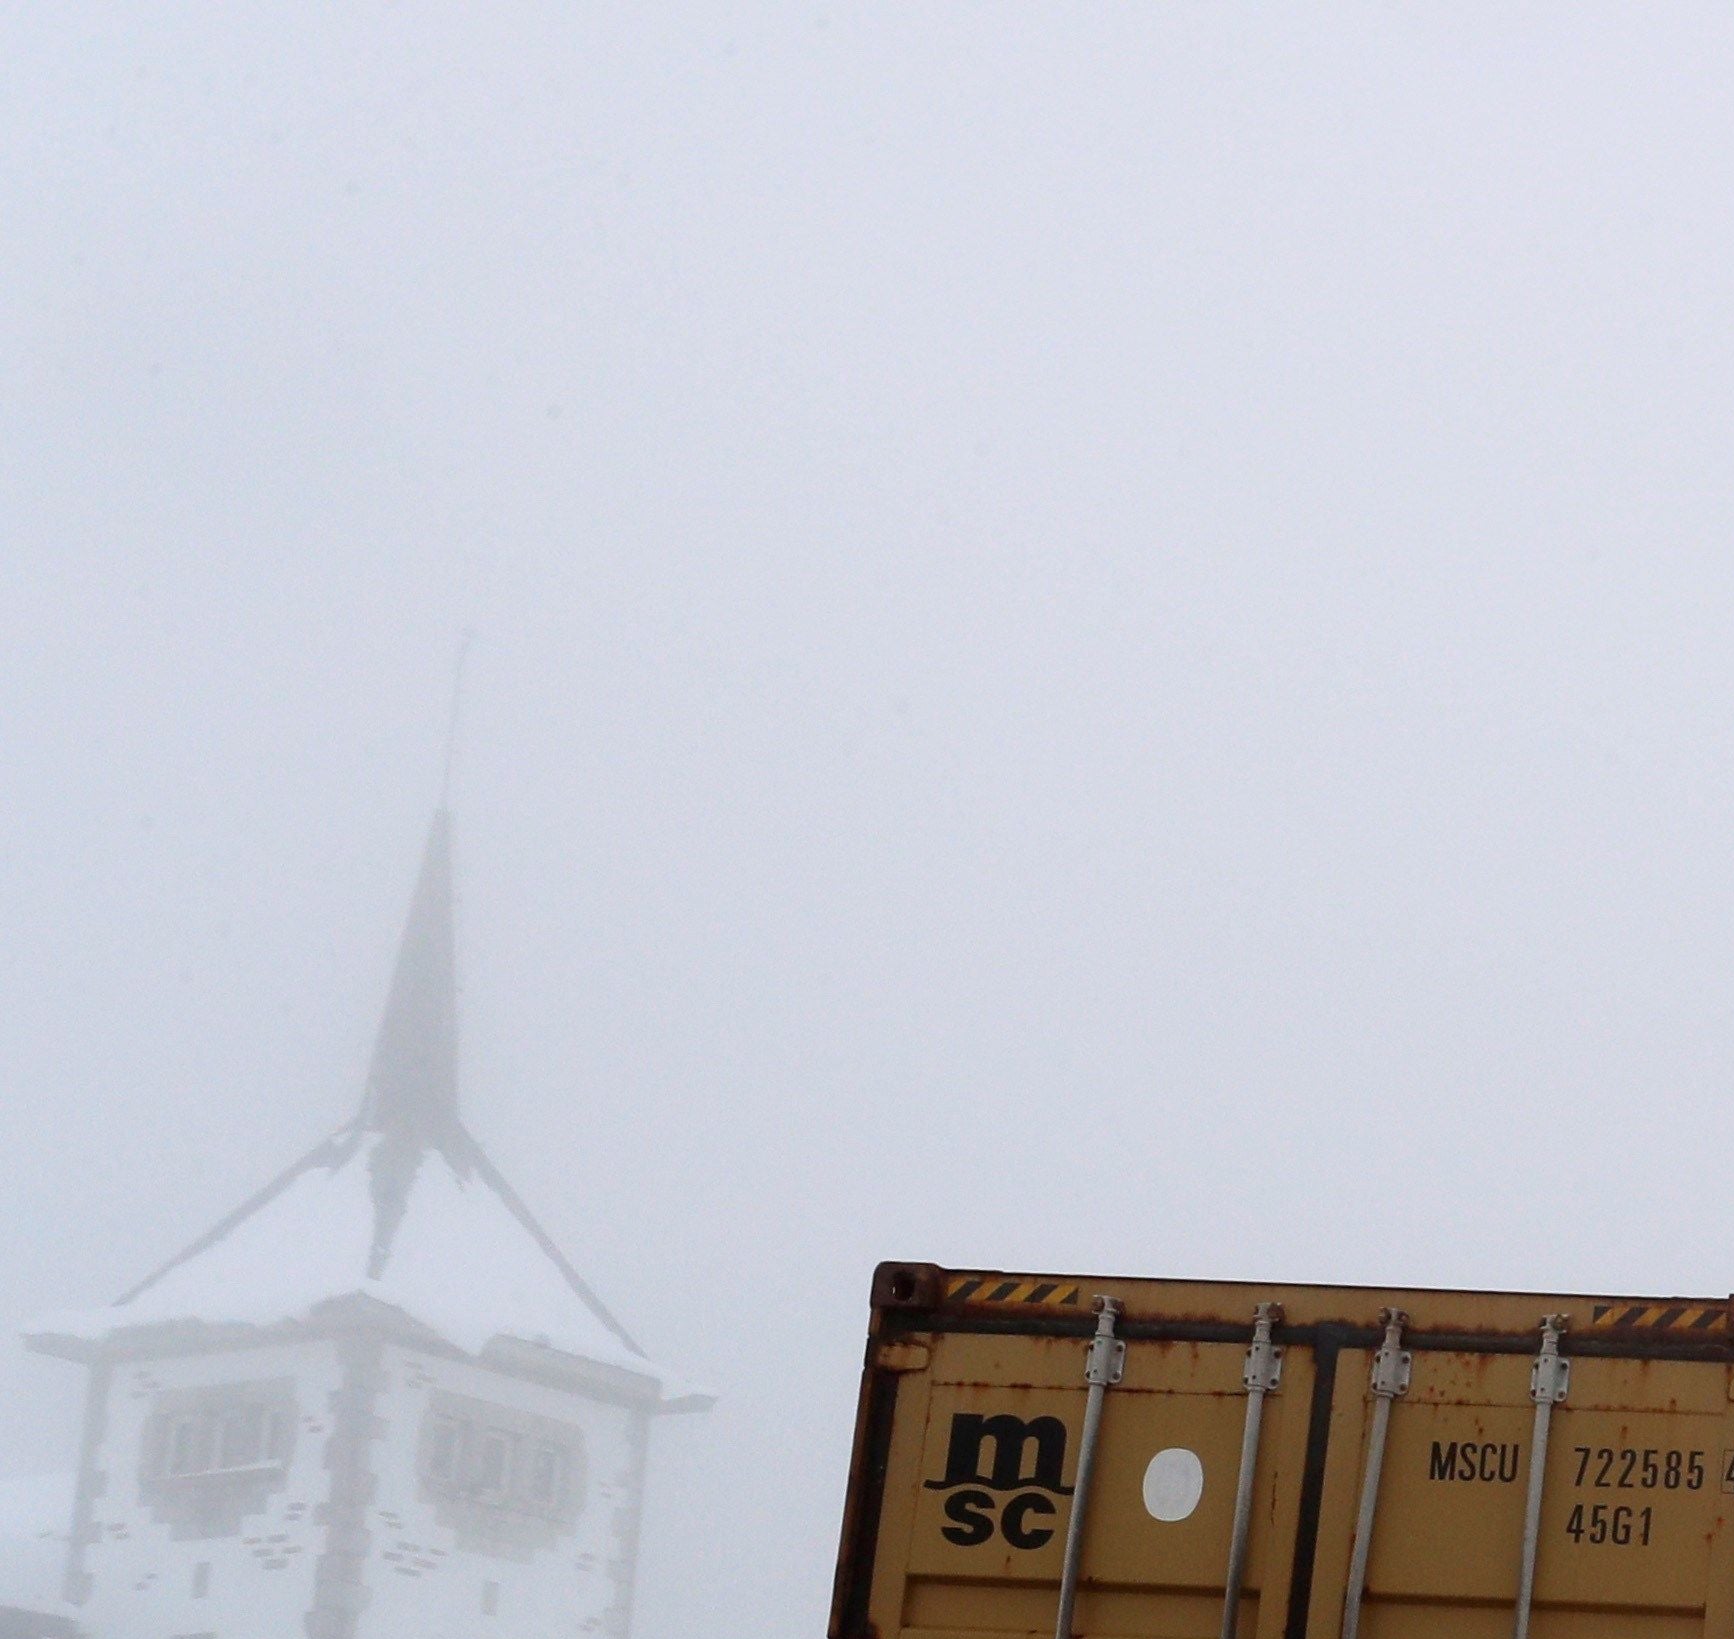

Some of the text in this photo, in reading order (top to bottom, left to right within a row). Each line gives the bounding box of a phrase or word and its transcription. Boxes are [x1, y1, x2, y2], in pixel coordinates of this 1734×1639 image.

[1428, 1442, 1520, 1484] MSCU
[1573, 1446, 1706, 1491] 722585
[1566, 1504, 1654, 1547] 45G1
